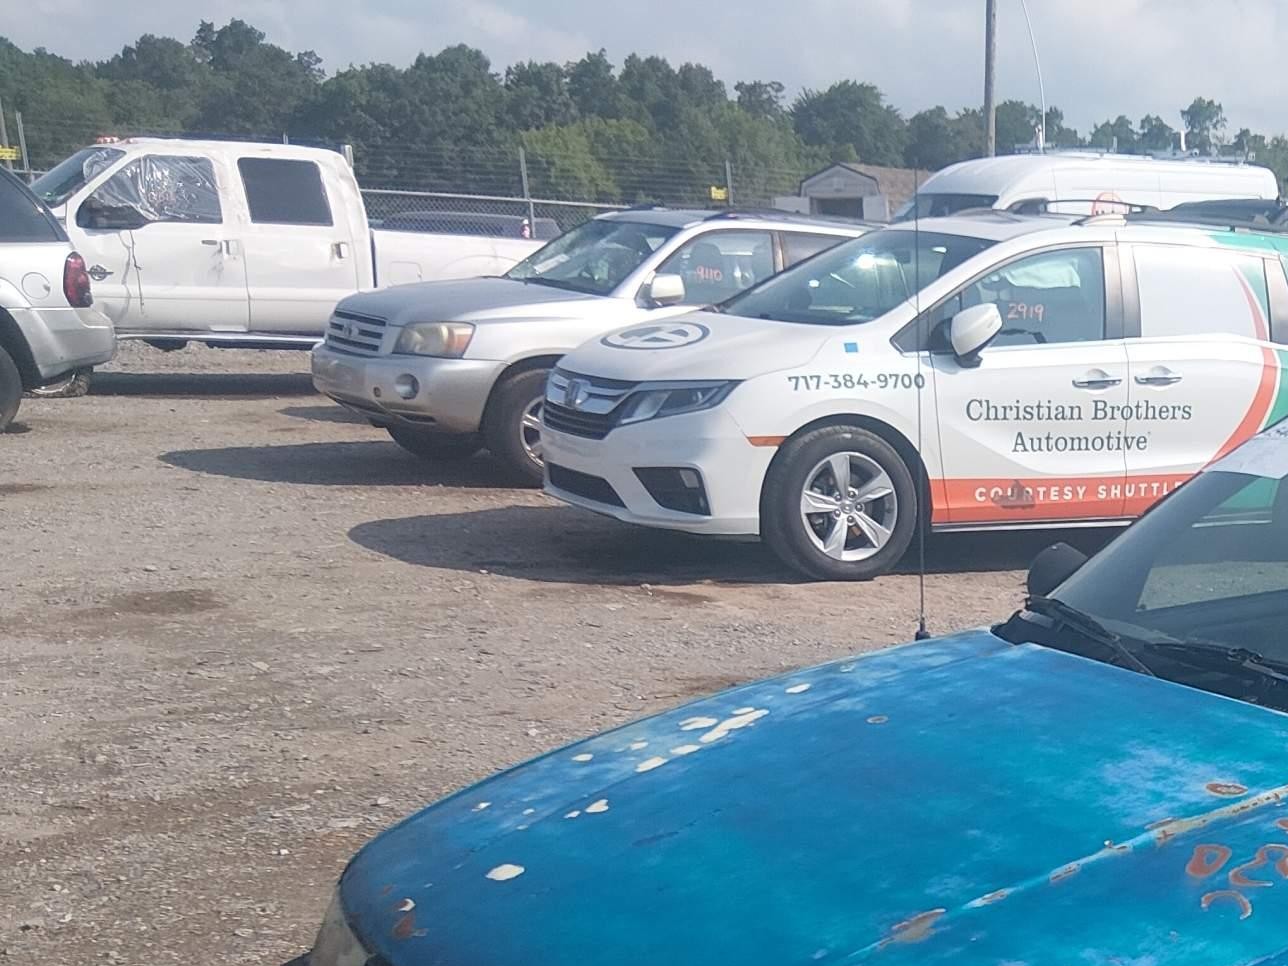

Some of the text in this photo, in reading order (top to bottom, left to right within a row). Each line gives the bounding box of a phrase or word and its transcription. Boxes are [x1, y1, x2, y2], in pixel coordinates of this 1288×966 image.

[1007, 302, 1045, 322] 2919
[787, 372, 926, 392] 717-384-9700
[965, 398, 1193, 422] Christian Brothers
[1011, 430, 1148, 453] Automotive
